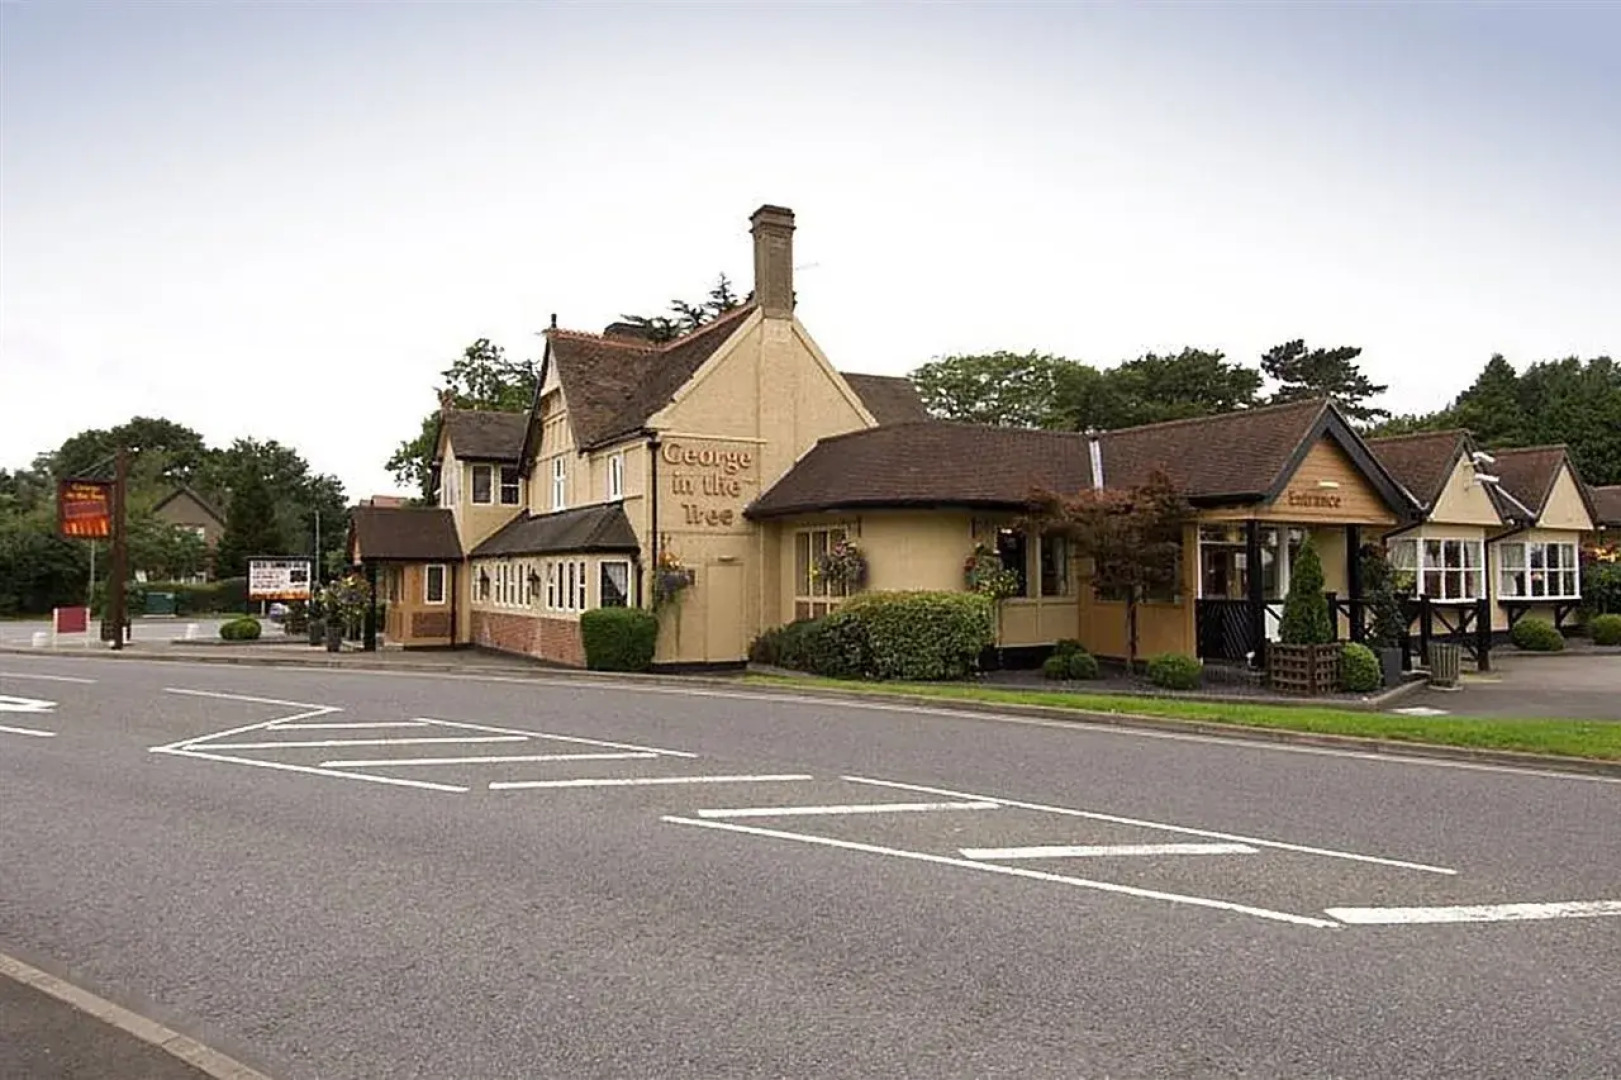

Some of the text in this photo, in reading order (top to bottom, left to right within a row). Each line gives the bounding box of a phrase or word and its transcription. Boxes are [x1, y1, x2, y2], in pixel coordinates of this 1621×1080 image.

[662, 443, 751, 475] George
[672, 470, 741, 498] in the
[1287, 489, 1341, 508] Entrance
[681, 502, 734, 526] Tree
